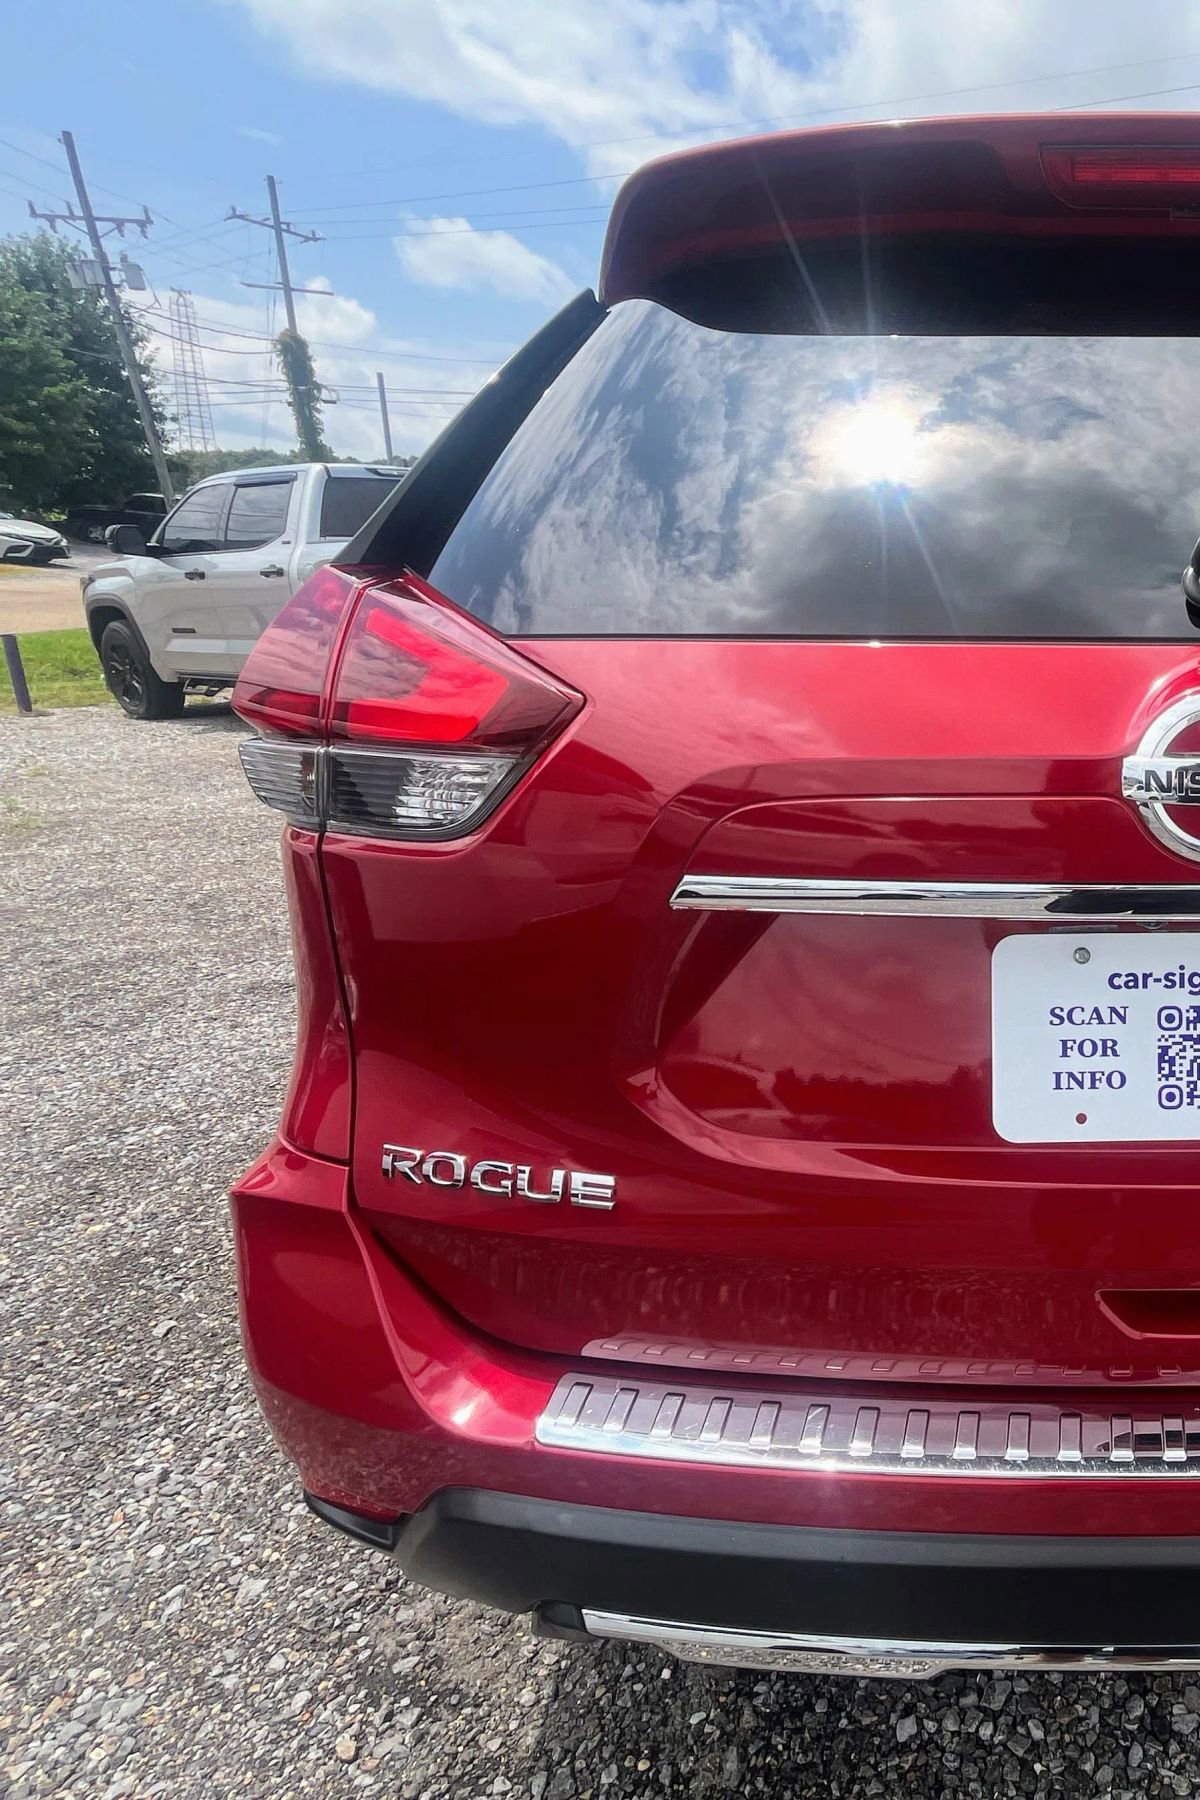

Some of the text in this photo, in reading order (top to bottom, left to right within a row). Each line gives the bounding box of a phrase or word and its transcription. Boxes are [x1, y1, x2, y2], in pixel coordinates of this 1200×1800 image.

[1049, 1005, 1129, 1027] SCAN
[1059, 1038, 1120, 1059] FOR
[1052, 1069, 1127, 1091] INFO
[381, 1143, 617, 1211] ROGUE
